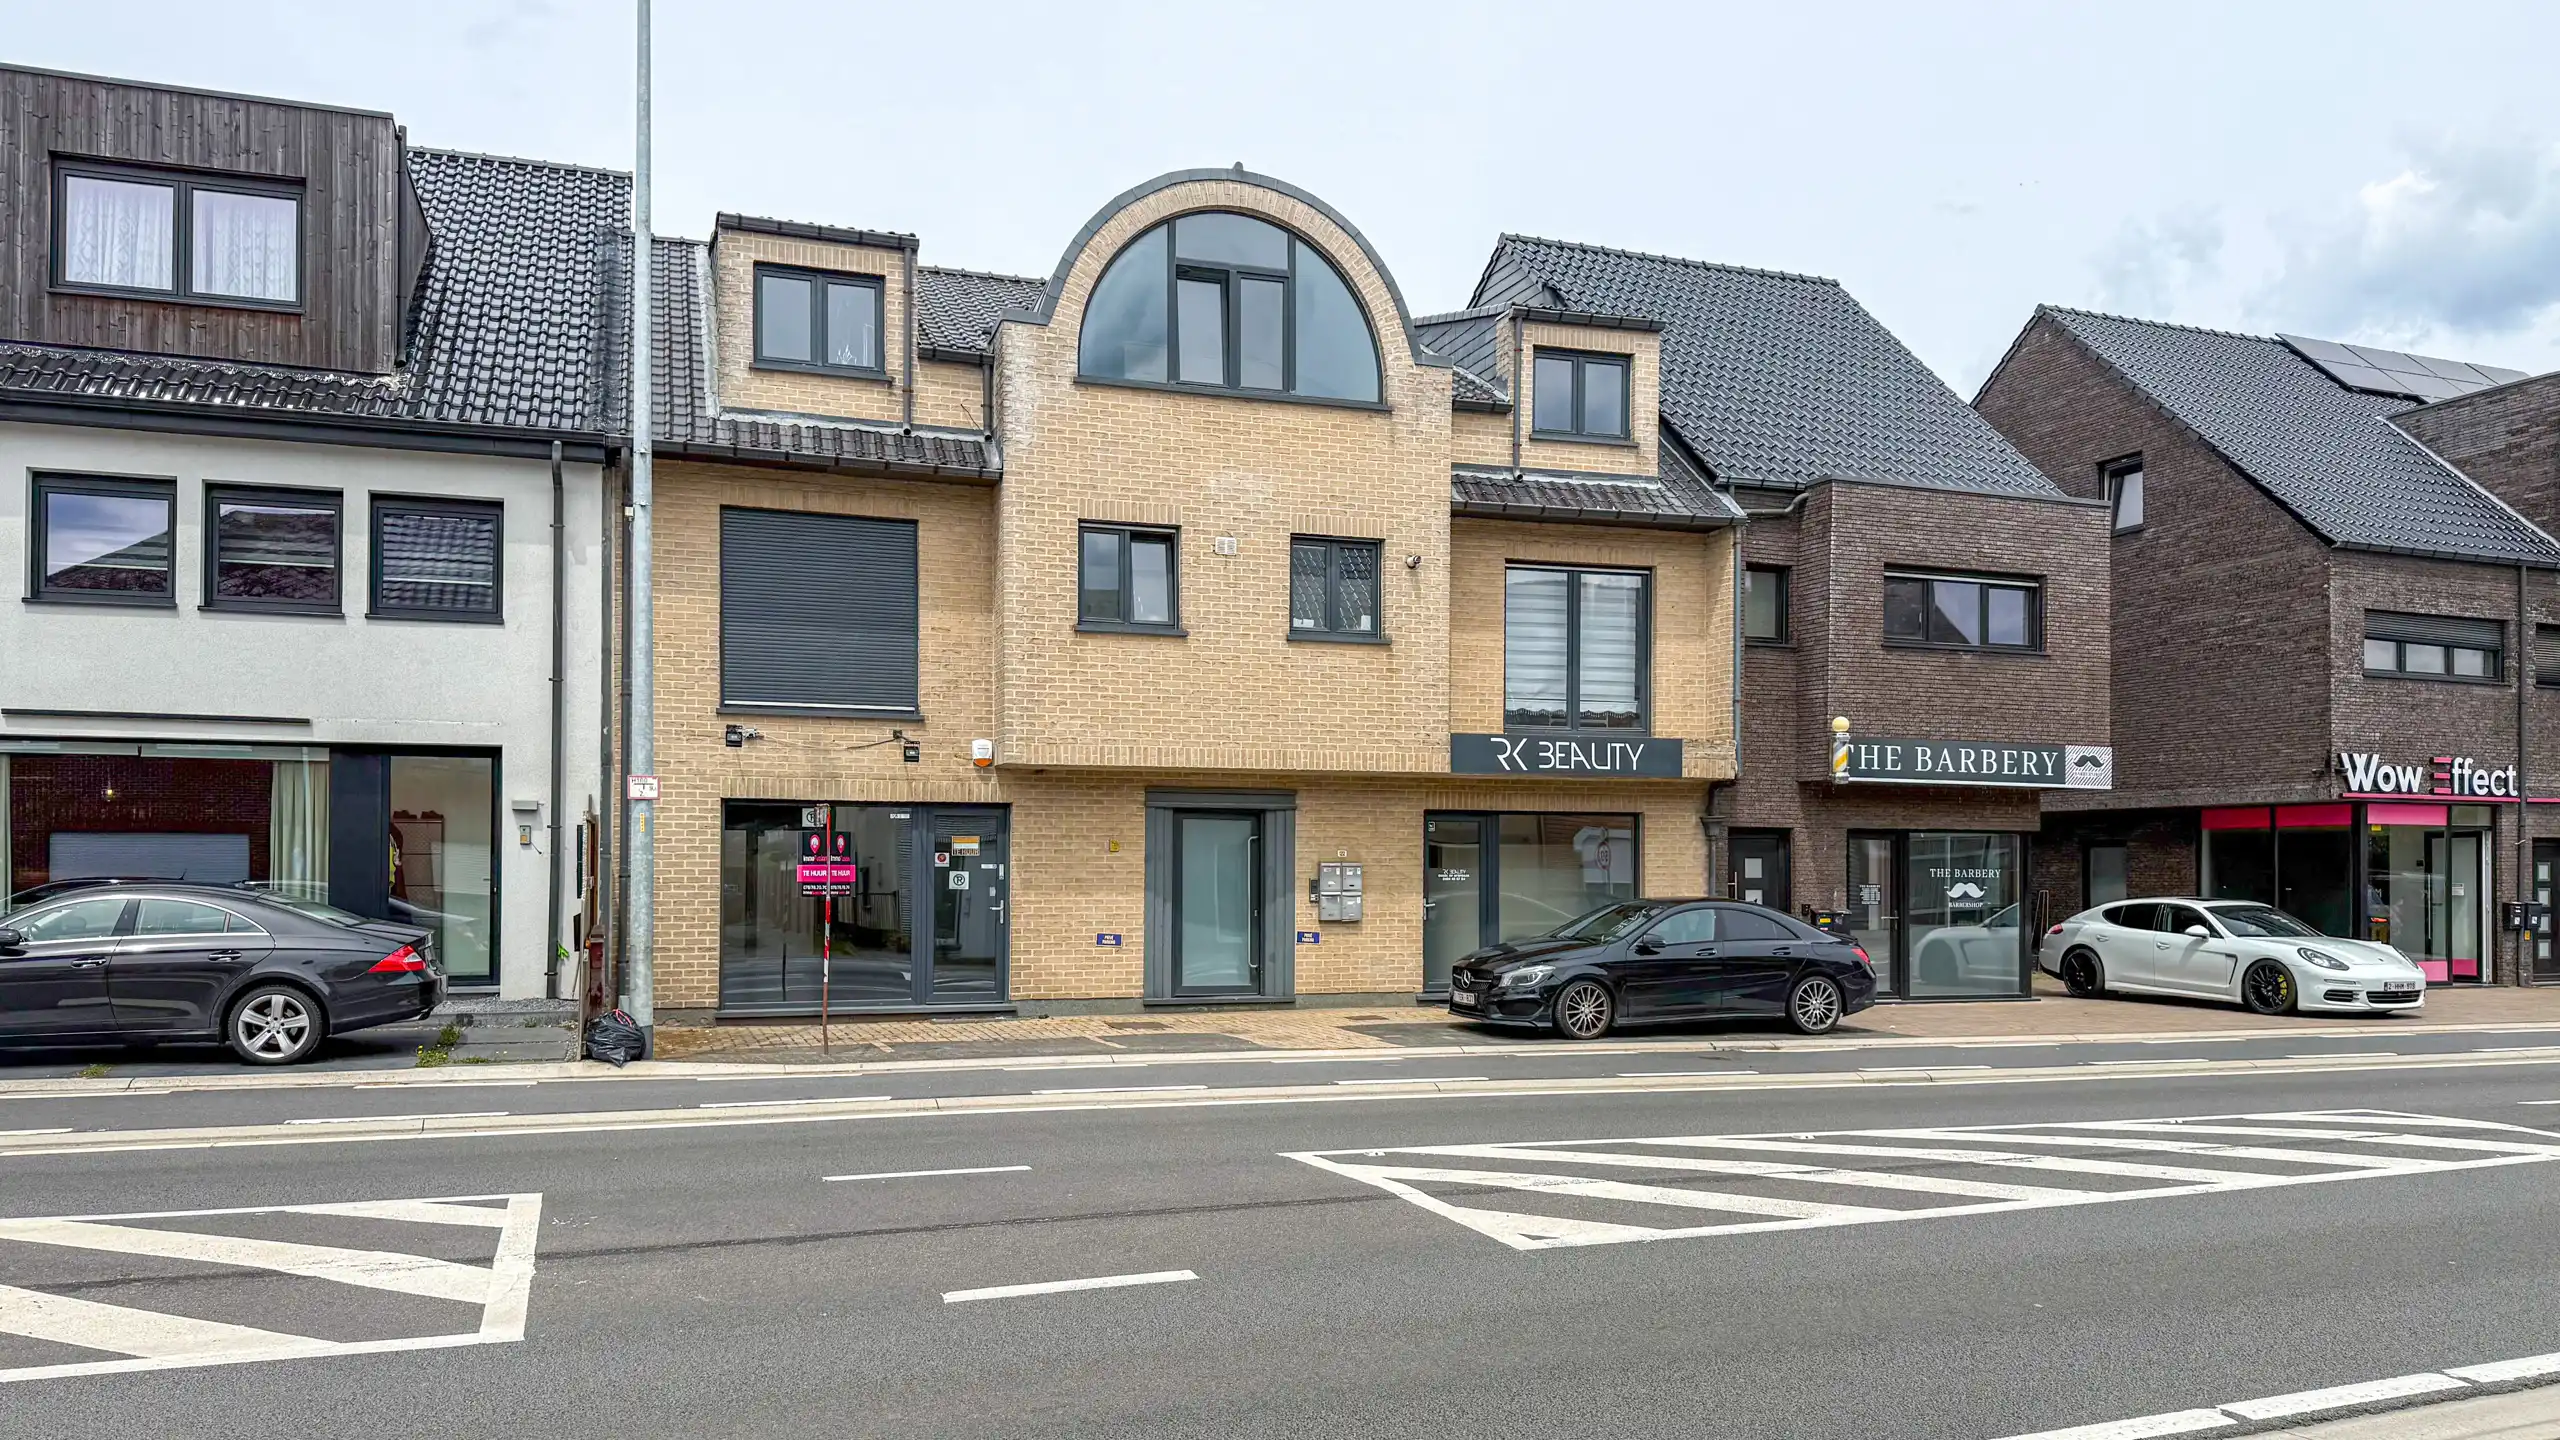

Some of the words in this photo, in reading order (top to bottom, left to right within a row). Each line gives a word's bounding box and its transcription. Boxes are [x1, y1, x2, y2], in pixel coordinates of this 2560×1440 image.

[1490, 737, 1529, 771] RK
[1538, 741, 1645, 771] BEAUTY
[1915, 746, 2059, 776] BARBERY
[2341, 752, 2423, 792] Wow
[2432, 756, 2519, 796] Effect
[1929, 868, 1951, 878] THE
[1954, 868, 2002, 878] BARBERY
